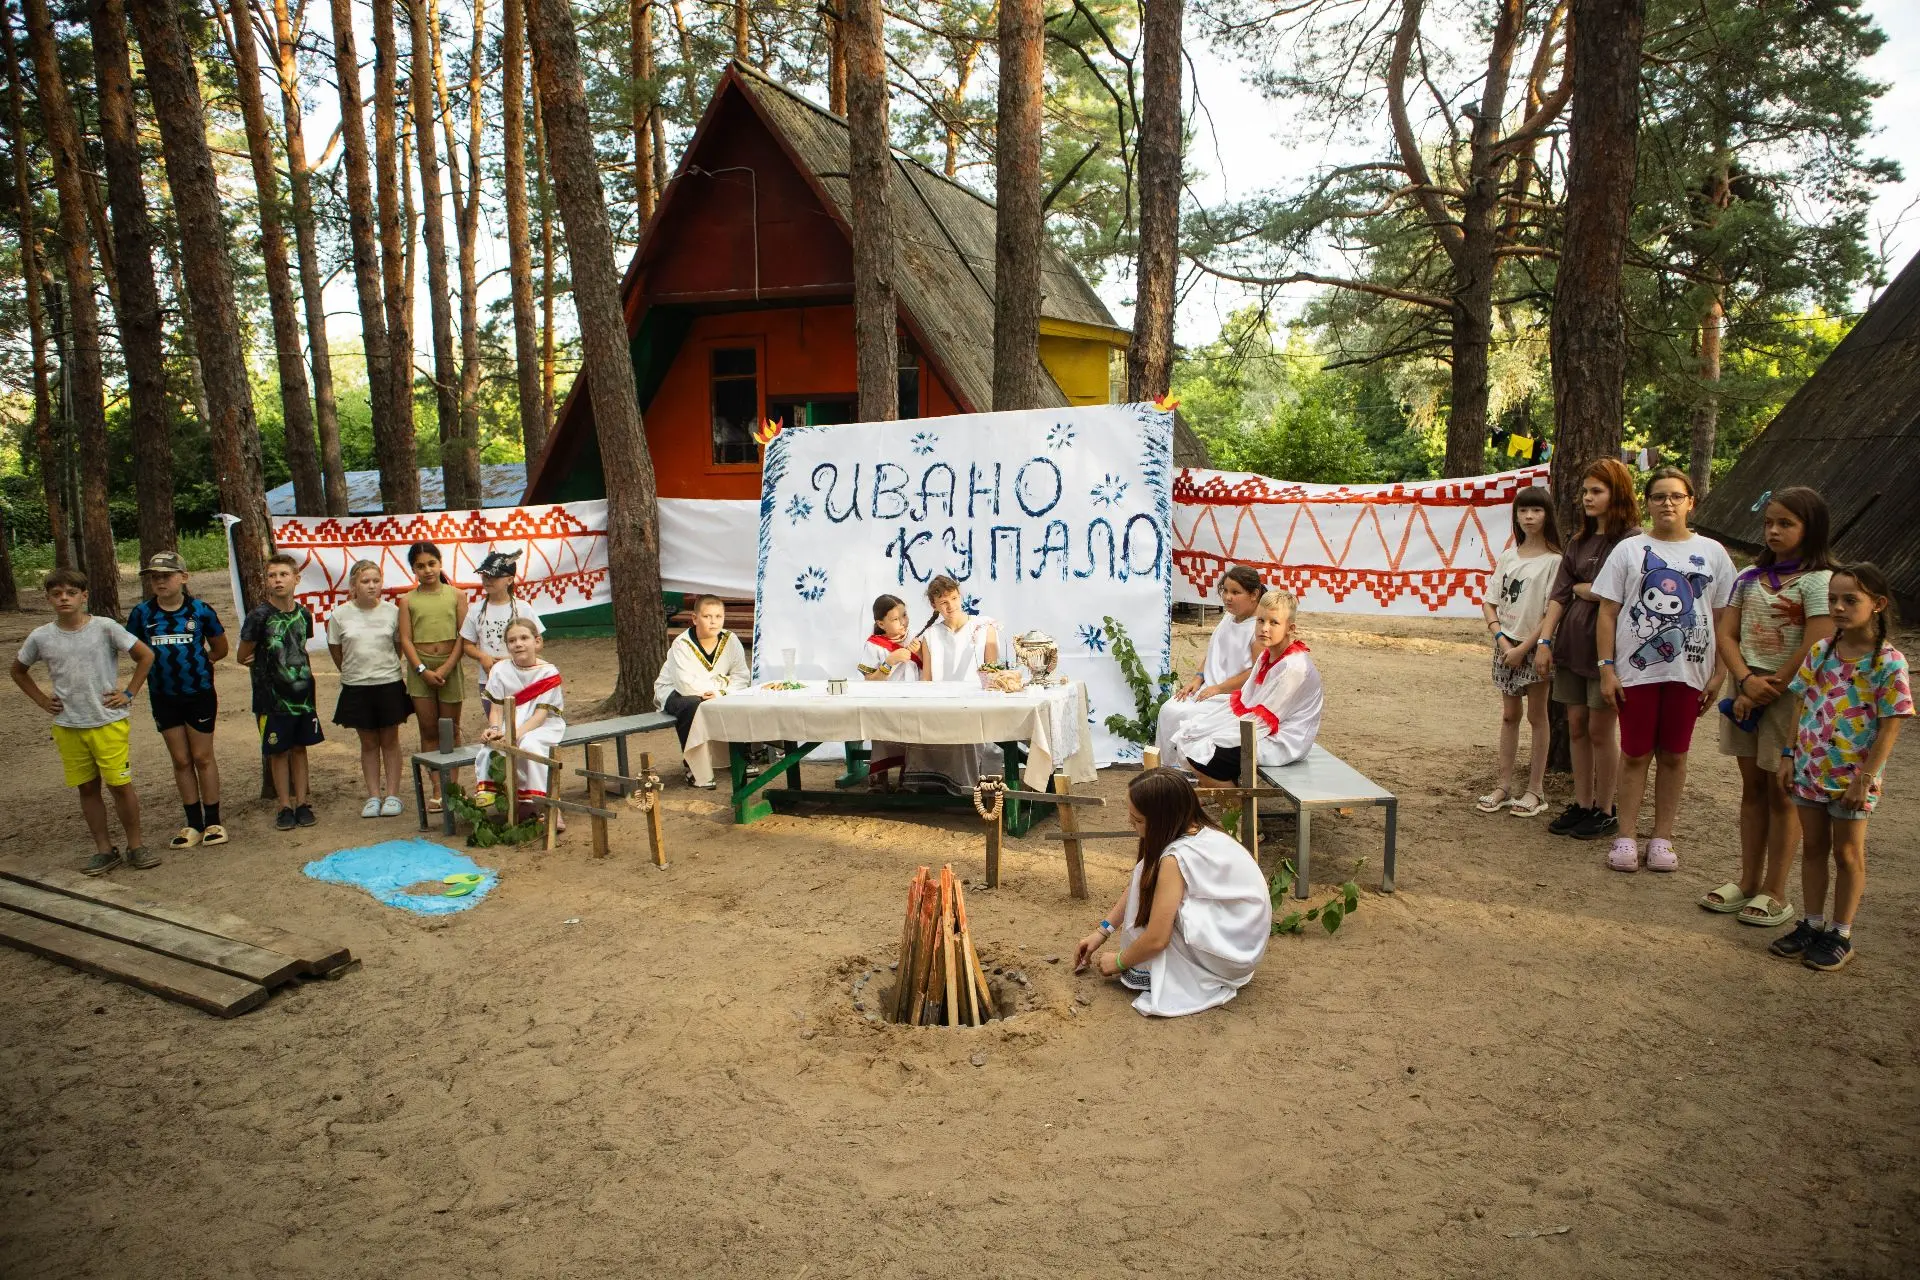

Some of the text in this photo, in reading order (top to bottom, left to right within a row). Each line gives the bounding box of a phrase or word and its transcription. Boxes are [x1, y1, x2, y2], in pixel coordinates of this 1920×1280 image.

[811, 456, 1062, 523] ИВАНО
[886, 513, 1164, 586] КУПАЛО
[1684, 628, 1709, 644] FUN
